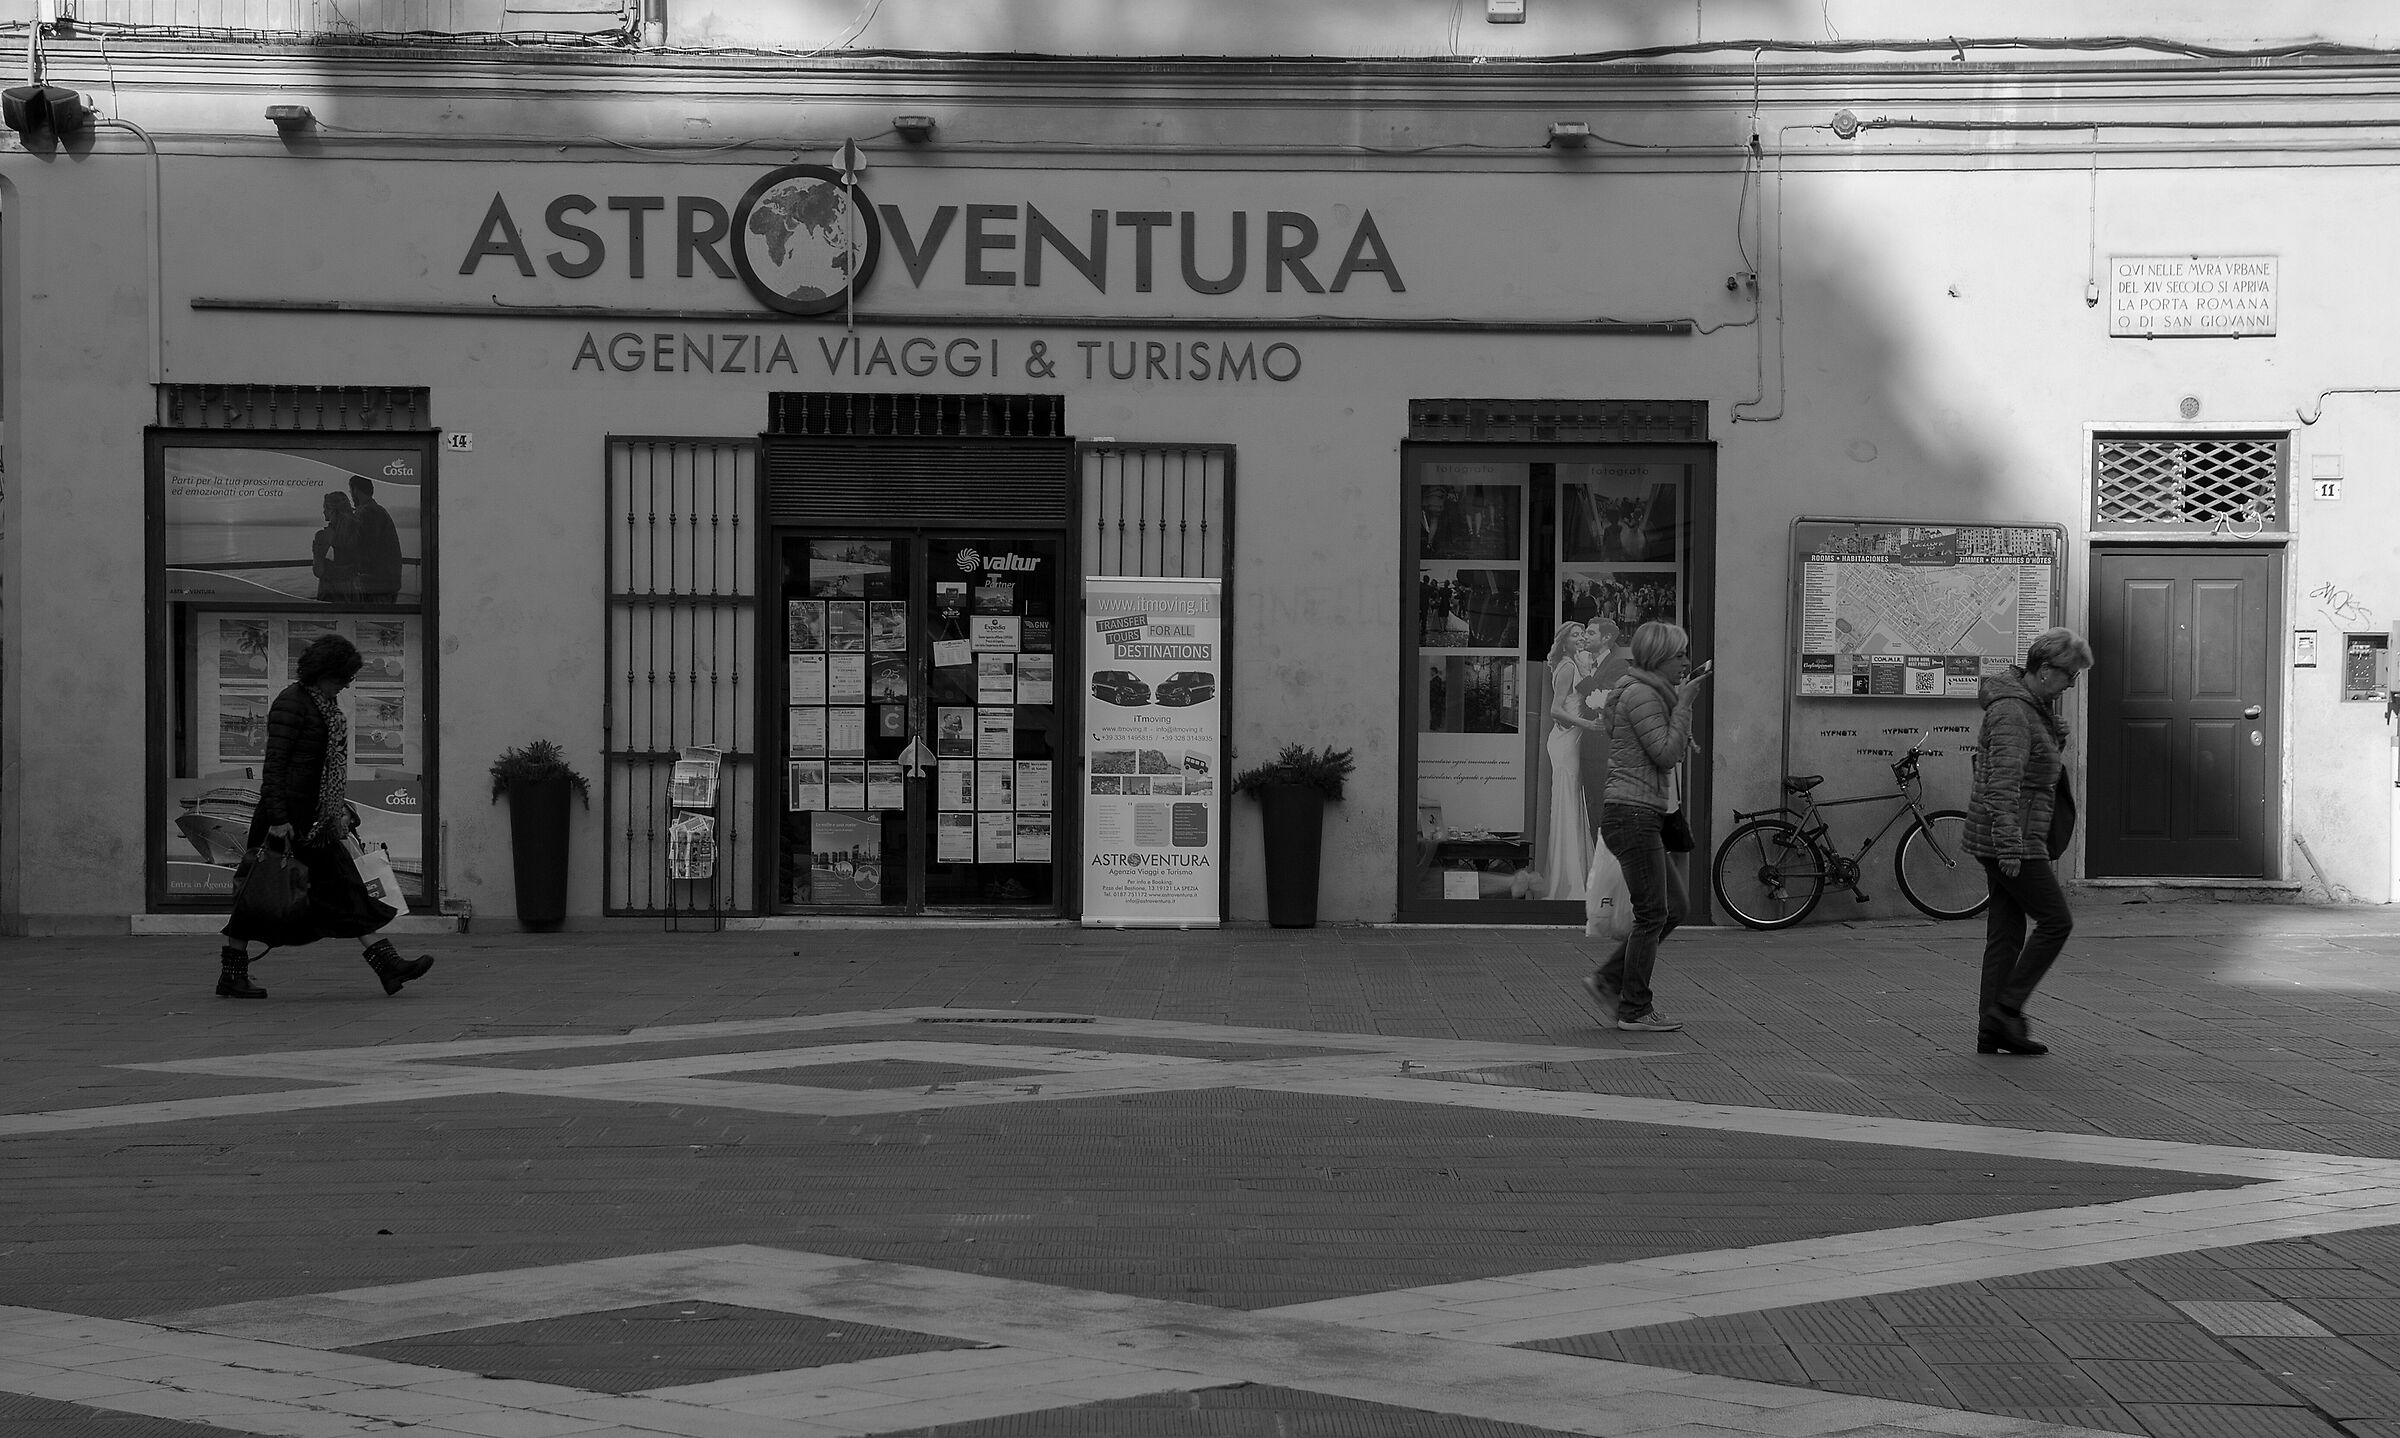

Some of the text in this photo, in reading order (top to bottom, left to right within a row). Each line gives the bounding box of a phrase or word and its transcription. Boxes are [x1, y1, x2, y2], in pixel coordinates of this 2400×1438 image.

[461, 163, 1406, 318] ASTROVENTURA
[2119, 264, 2270, 276] QVI NELLE MVRA VRBANE
[2119, 281, 2270, 293] DEL XIV SECOLO SI APRIVA
[2118, 298, 2270, 310] LA PORTA ROMANA
[2118, 315, 2270, 327] O DI SAN GIOVANNI
[574, 331, 1303, 381] AGENZIA VIAGGI & TURISMO
[452, 435, 466, 448] 14
[383, 464, 414, 476] Costa
[171, 475, 324, 489] Parti per la tua prossima crociera
[171, 487, 284, 497] ed emozionati con Costa
[2321, 484, 2335, 497] 11
[983, 553, 1042, 571] valtur
[1811, 554, 1890, 563] ROOMS HABITACIONES
[1959, 556, 1985, 564] ZIMMER
[1990, 557, 2025, 565] CHAMBRES
[985, 579, 1017, 588] Partner
[1098, 596, 1210, 615] www.itmoving.it
[1034, 621, 1050, 629] GNV
[1099, 615, 1146, 630] TRANSFER
[1108, 629, 1139, 642] TOURS
[1150, 625, 1192, 636] FOR ALL
[1118, 645, 1210, 659] DESTINATIONS
[1133, 714, 1172, 724] iTmoving
[385, 794, 417, 806] Costa
[1092, 852, 1210, 867] ASTROVENTURA
[1109, 868, 1136, 877] Agenzia
[1138, 868, 1159, 878] Viaggi
[193, 880, 202, 888] in
[203, 881, 234, 890] Agenzia
